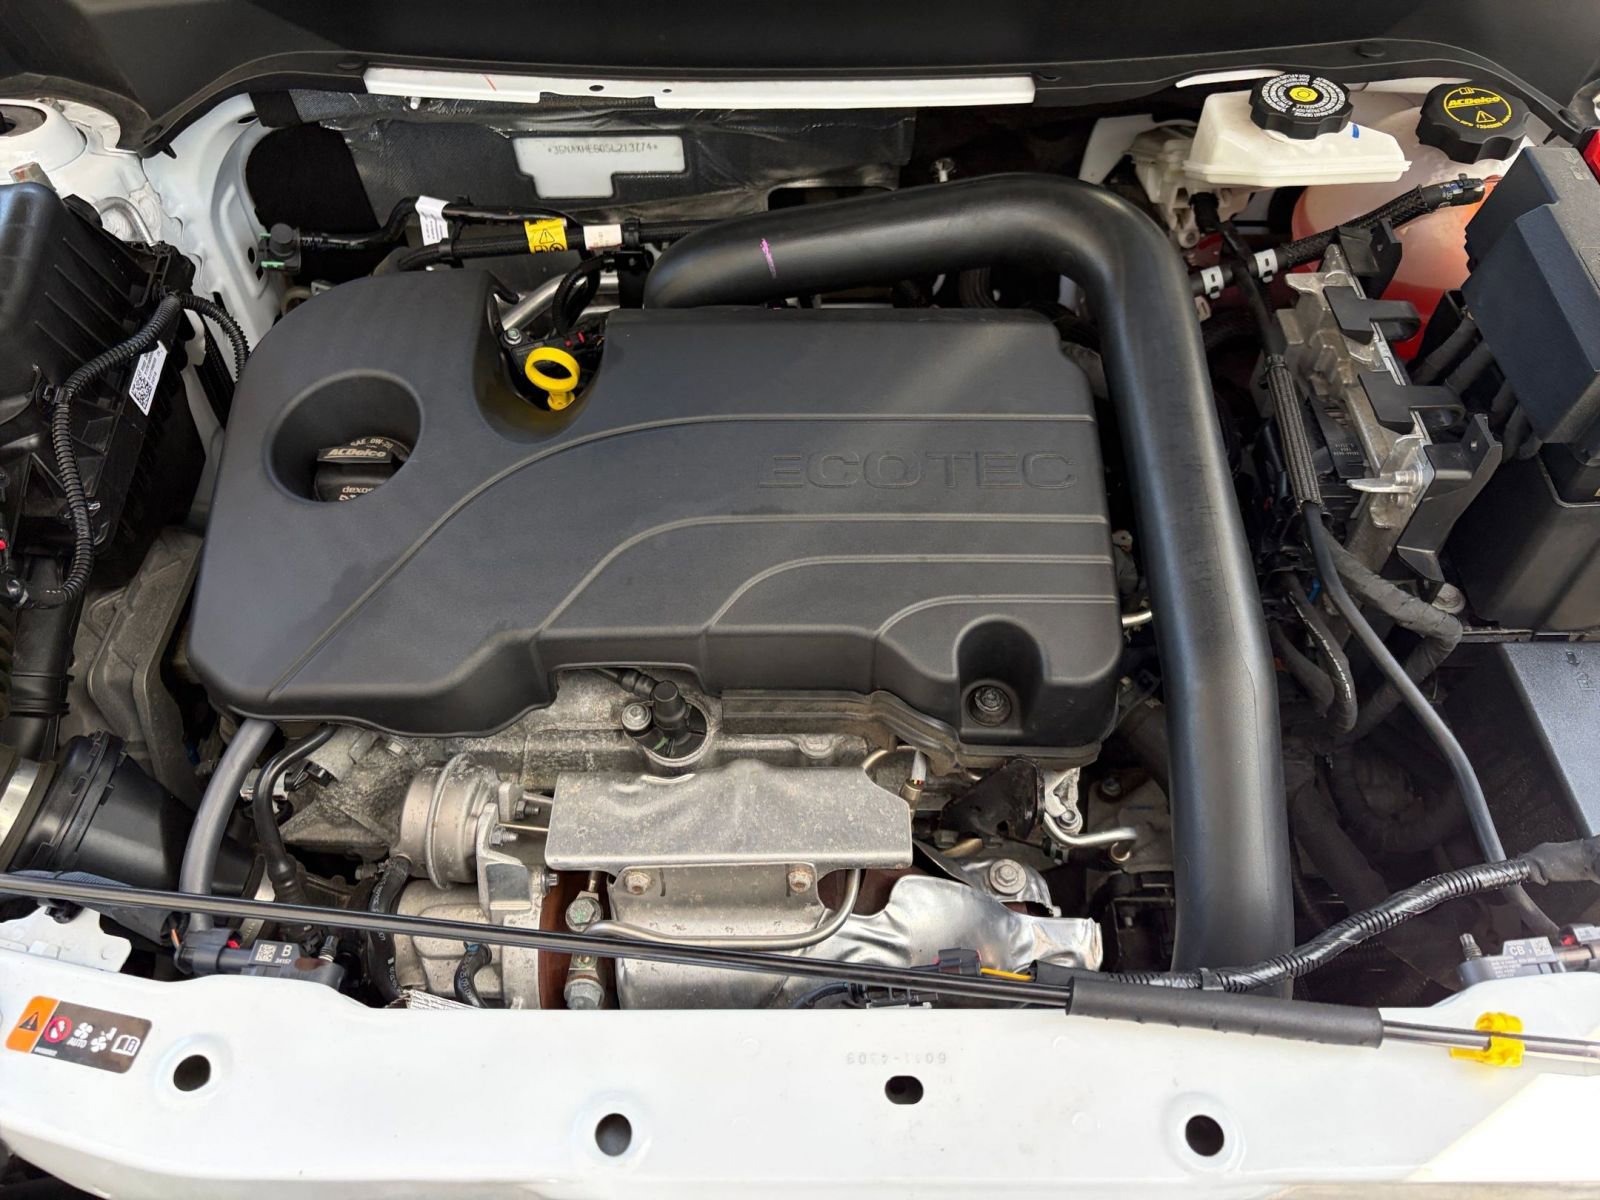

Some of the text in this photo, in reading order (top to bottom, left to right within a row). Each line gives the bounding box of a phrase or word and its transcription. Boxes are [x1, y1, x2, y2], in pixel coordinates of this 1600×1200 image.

[1447, 96, 1501, 108] ACDelco
[326, 447, 387, 459] ACDelco
[758, 450, 1078, 490] ECOTEC
[281, 944, 293, 957] B
[1509, 945, 1526, 956] CB
[66, 1037, 88, 1049] AUTO
